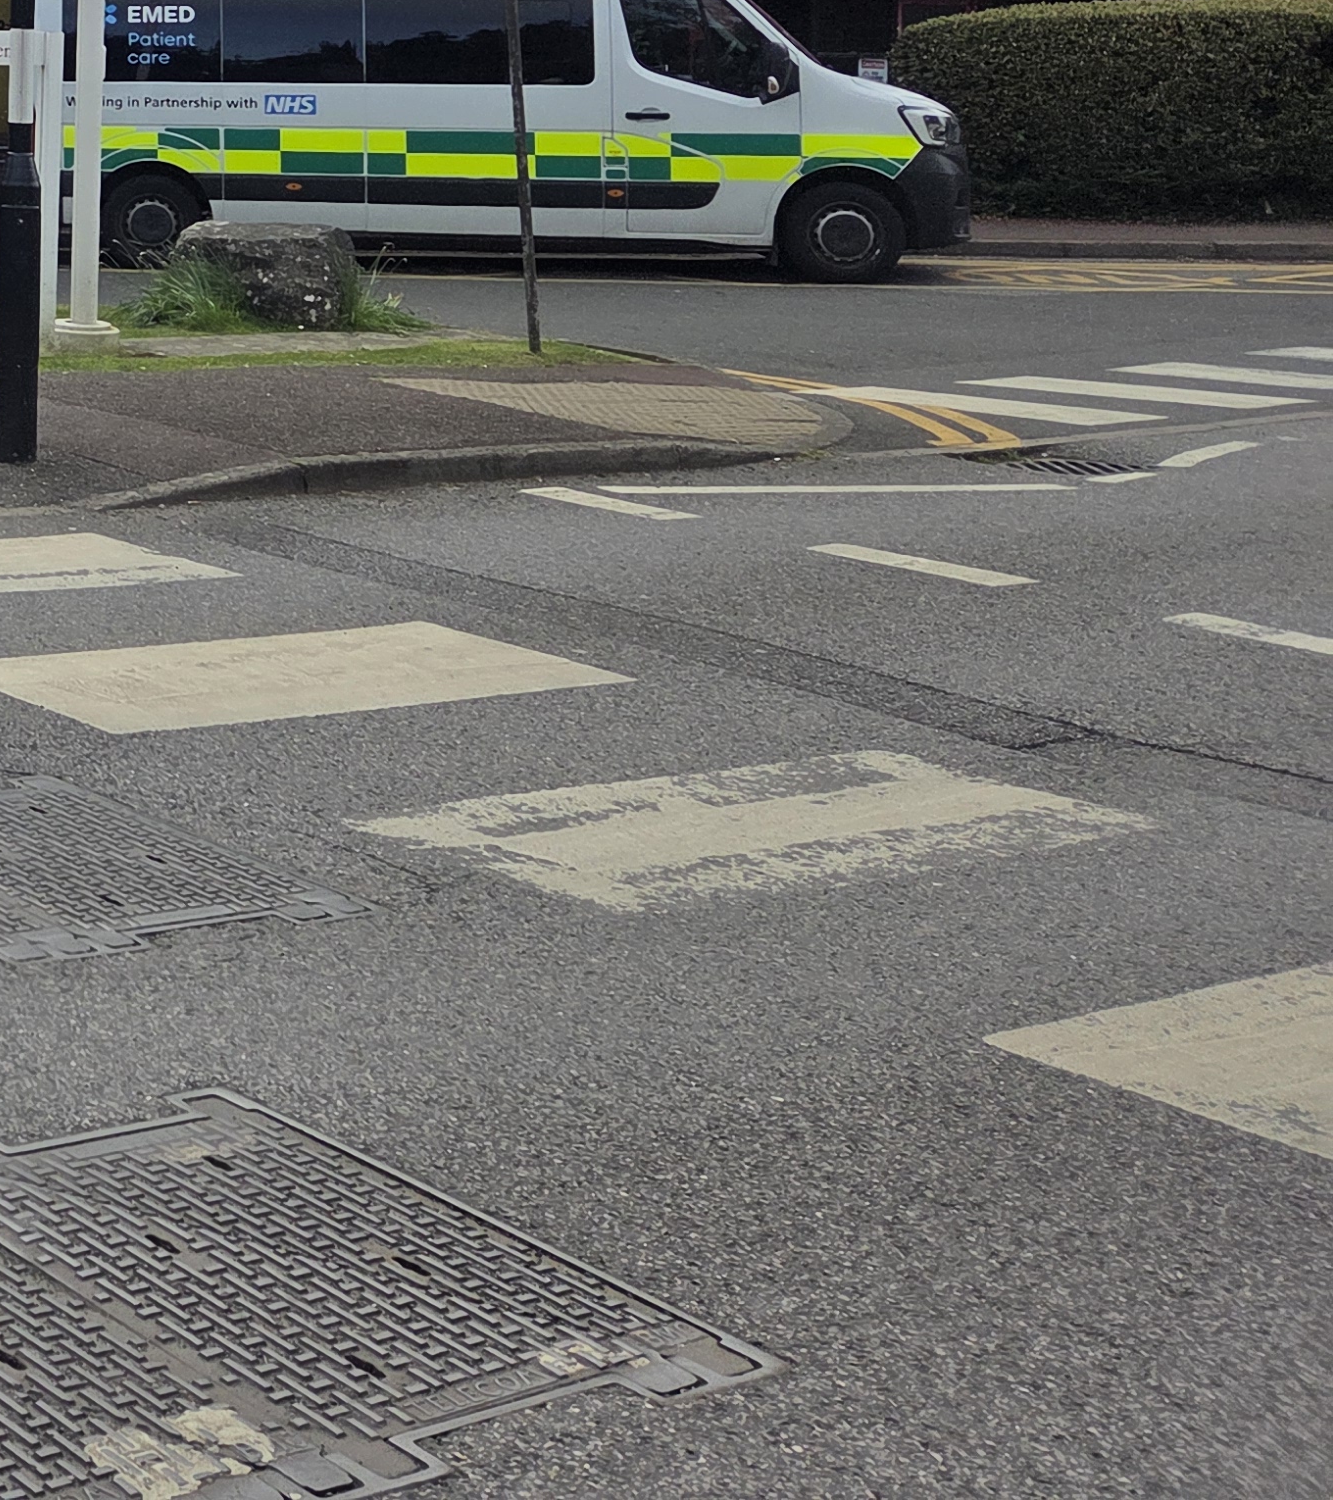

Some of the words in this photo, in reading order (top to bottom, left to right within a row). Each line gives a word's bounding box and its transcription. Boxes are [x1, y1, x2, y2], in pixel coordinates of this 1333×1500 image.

[127, 5, 196, 23] EMED
[128, 31, 196, 46] Patient
[127, 53, 170, 64] care
[65, 95, 123, 110] Wing
[127, 95, 140, 107] in
[144, 97, 222, 110] Partnership
[226, 96, 258, 109] with
[266, 96, 315, 113] NHS
